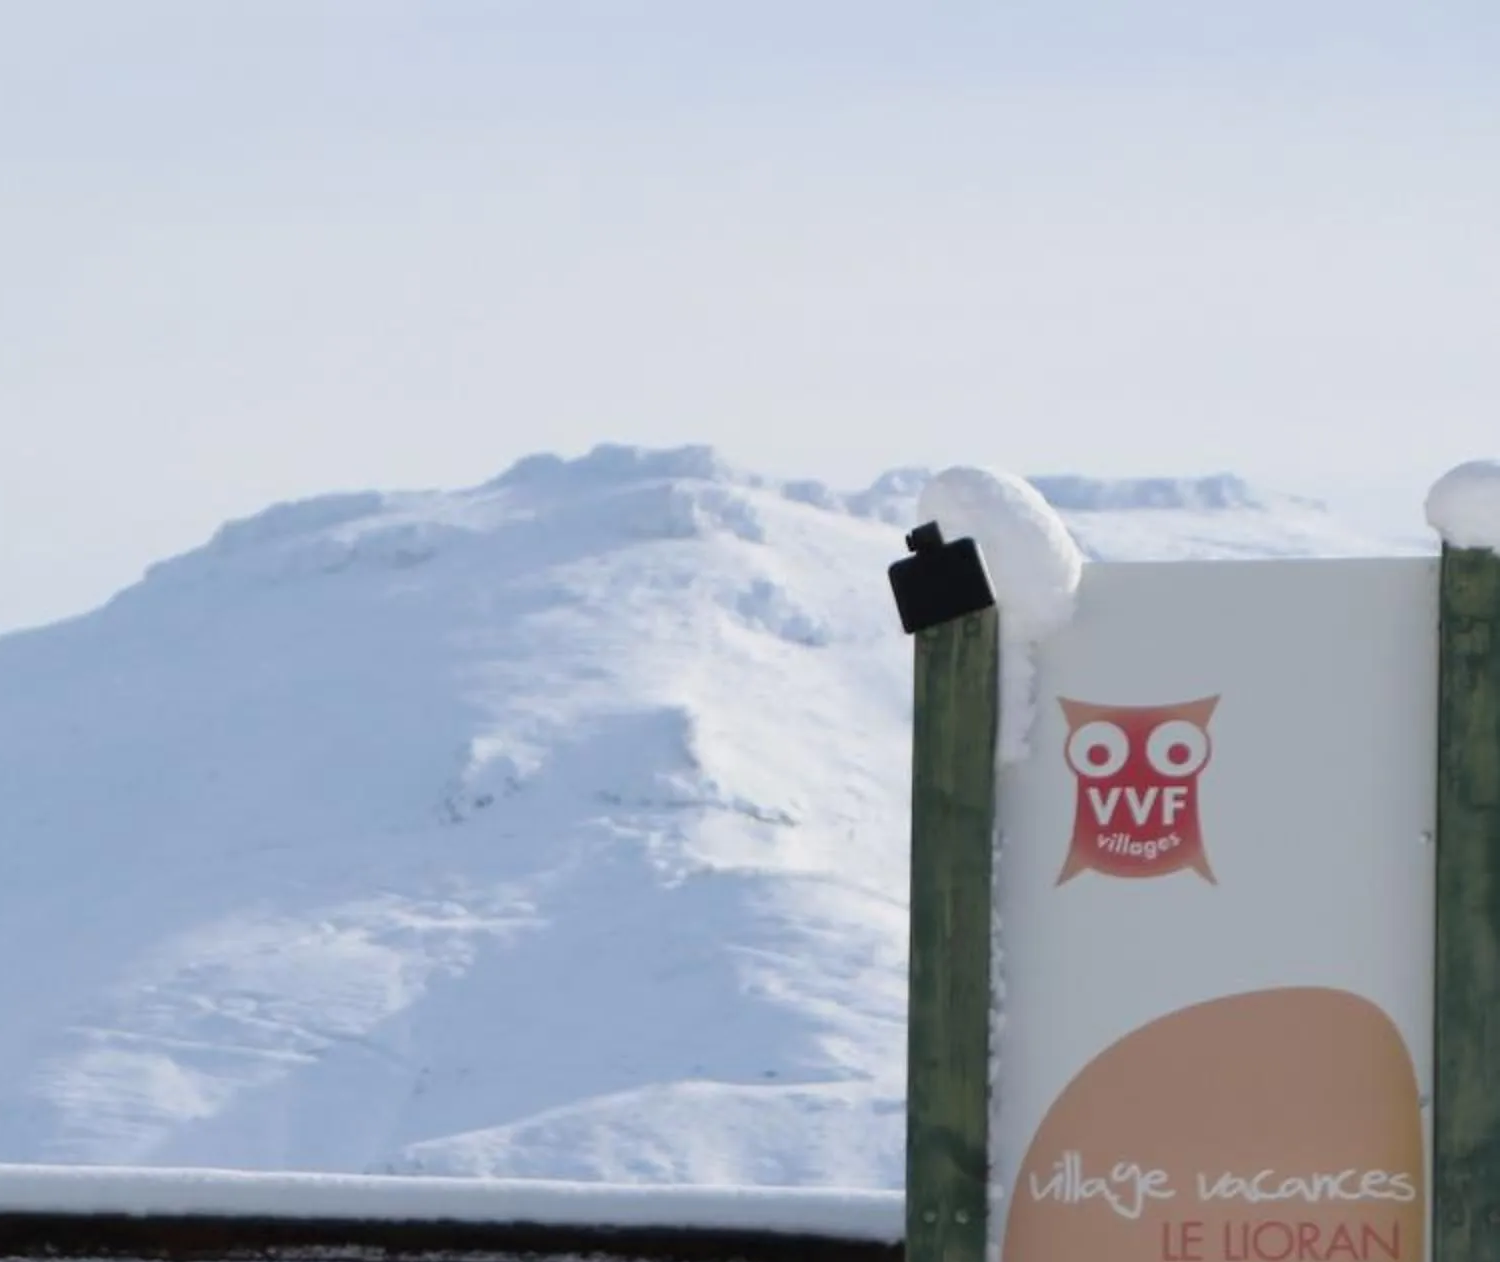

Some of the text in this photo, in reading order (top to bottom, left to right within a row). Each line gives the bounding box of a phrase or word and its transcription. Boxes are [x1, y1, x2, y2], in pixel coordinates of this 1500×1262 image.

[1086, 786, 1189, 827] VVF
[1097, 831, 1182, 860] villages
[1030, 1151, 1416, 1218] village vacances
[1162, 1221, 1400, 1262] LE LIORAN
